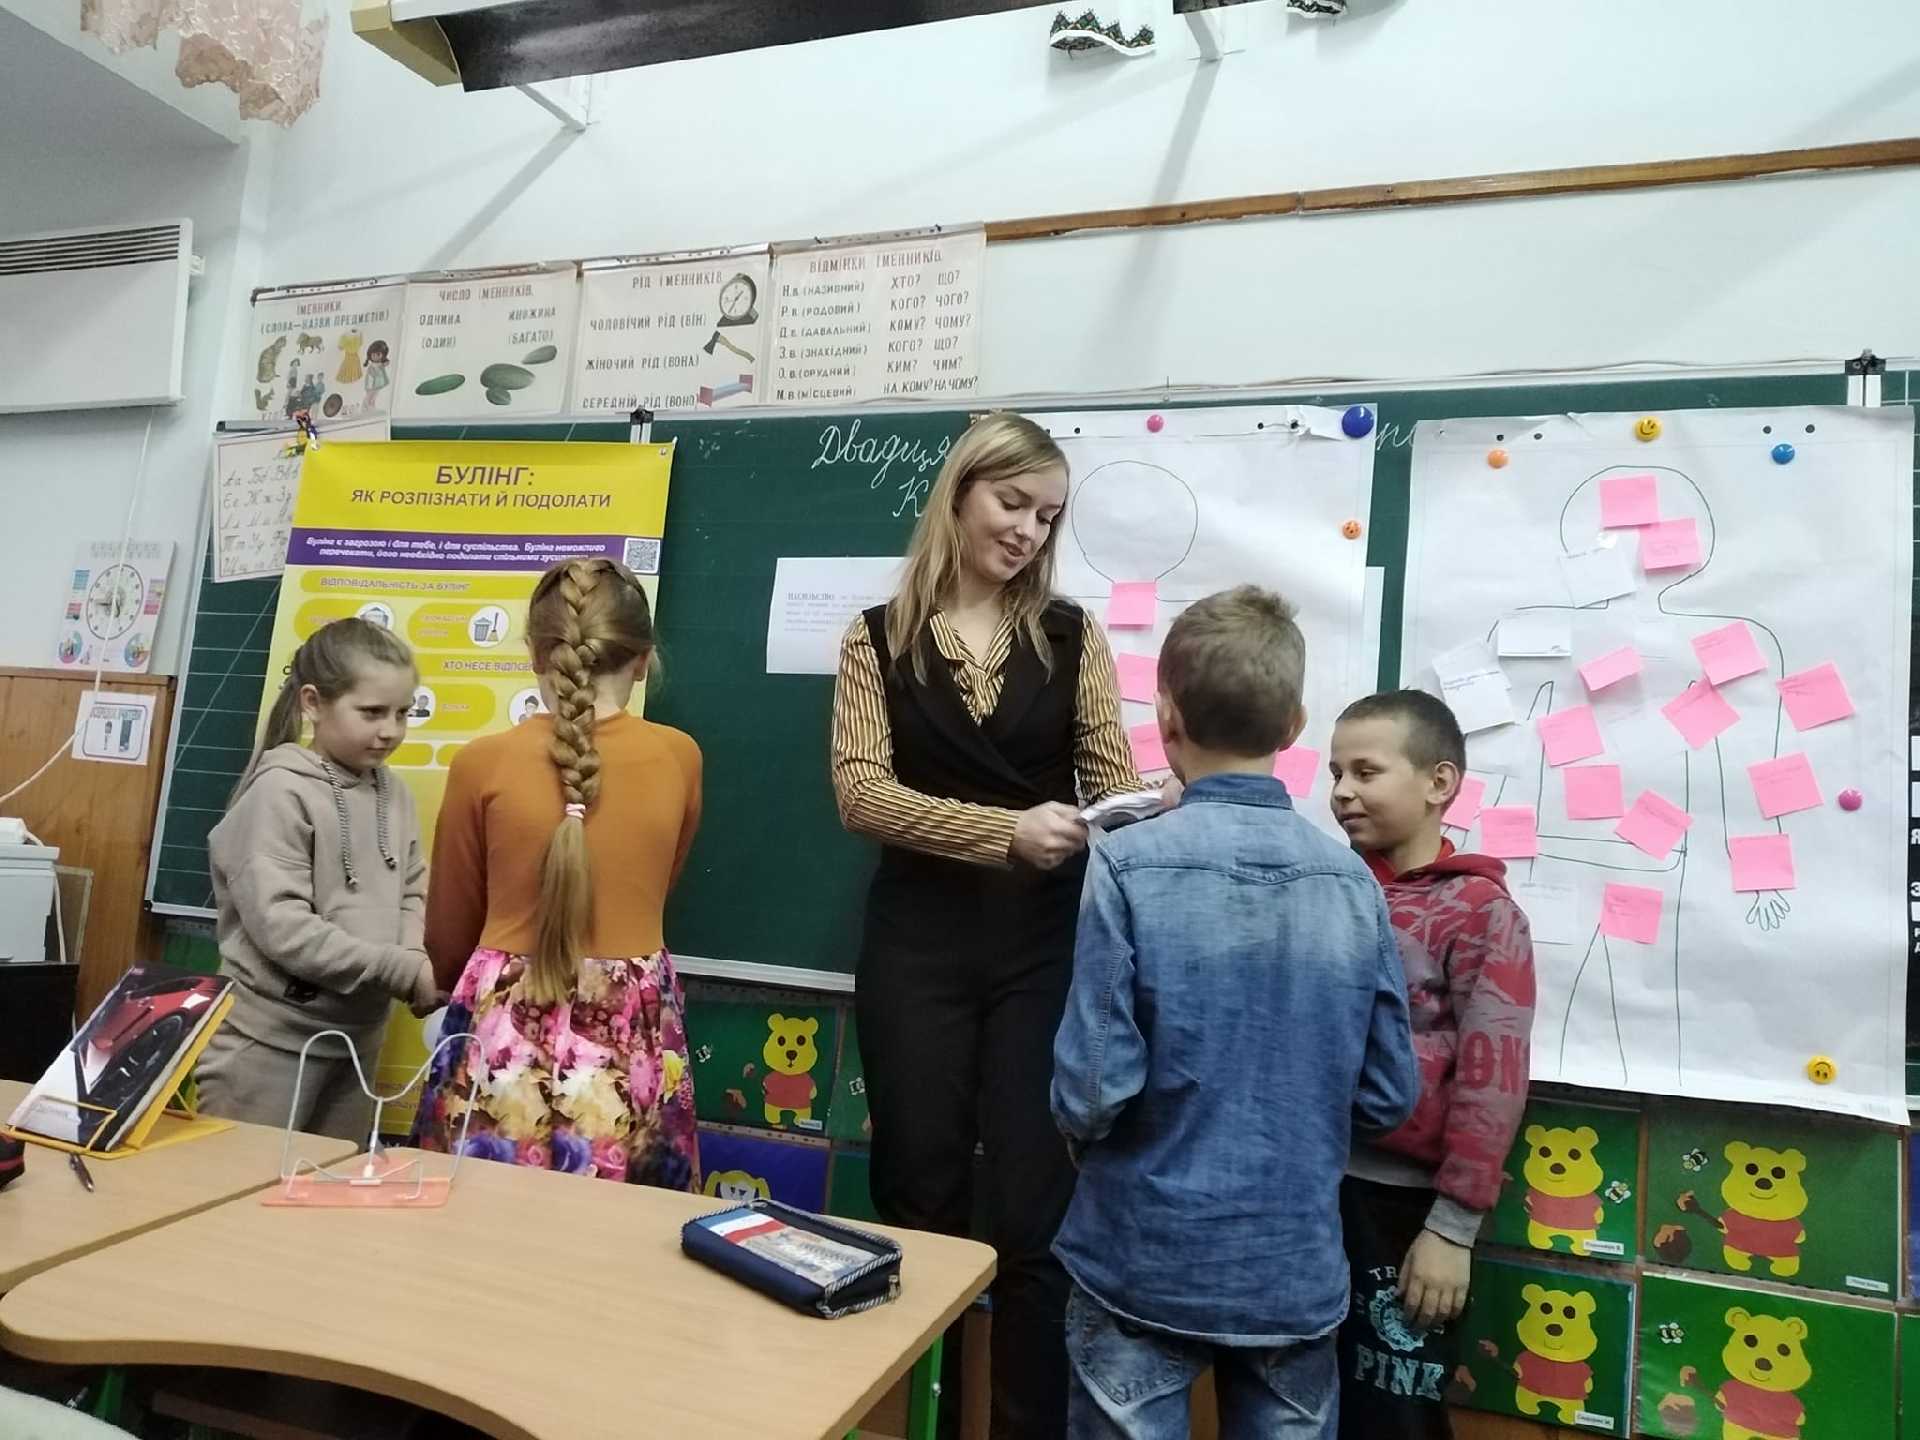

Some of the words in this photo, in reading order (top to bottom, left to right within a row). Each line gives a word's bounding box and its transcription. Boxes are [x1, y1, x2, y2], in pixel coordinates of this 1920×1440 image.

[809, 255, 866, 273] ВІДМІНКИ
[875, 250, 943, 268] ІМЕННИКІВ
[632, 275, 651, 289] РІД
[659, 271, 722, 287] ІМЕННИКІВ
[890, 273, 921, 290] ХТО?
[937, 270, 961, 287] ЩО?
[890, 295, 927, 312] КОГО?
[935, 291, 970, 308] ЧОГО?
[419, 313, 462, 326] ОДНИНА
[589, 314, 651, 331] ЧОЛОВІЧИЙ
[657, 314, 676, 328] РІД
[889, 315, 926, 332] КОМУ?
[934, 313, 972, 330] ЧОМУ?
[888, 337, 923, 353] КОГО?
[933, 335, 959, 352] ЩО?
[585, 356, 635, 370] ЖІНОЧИЙ
[641, 355, 661, 369] РІД
[663, 354, 700, 369] (ВОНА)
[886, 359, 918, 374] КИМ?
[932, 356, 963, 371] ЧИМ?
[883, 382, 899, 396] НА
[901, 378, 933, 394] КОМУ?
[948, 376, 979, 393] ЧОМУ?
[582, 394, 638, 409] СЕРЕДНІЙ
[643, 395, 661, 409] РІД
[435, 464, 535, 486] БУЛІНГ:
[351, 489, 375, 503] ЯК
[379, 490, 491, 507] РОЗПІЗНАТИ
[495, 491, 508, 507] Й
[512, 493, 612, 510] ПОДОЛАТИ
[443, 660, 464, 671] ХТО
[464, 660, 493, 672] НЕСЕ
[1355, 1344, 1444, 1401] PINK
